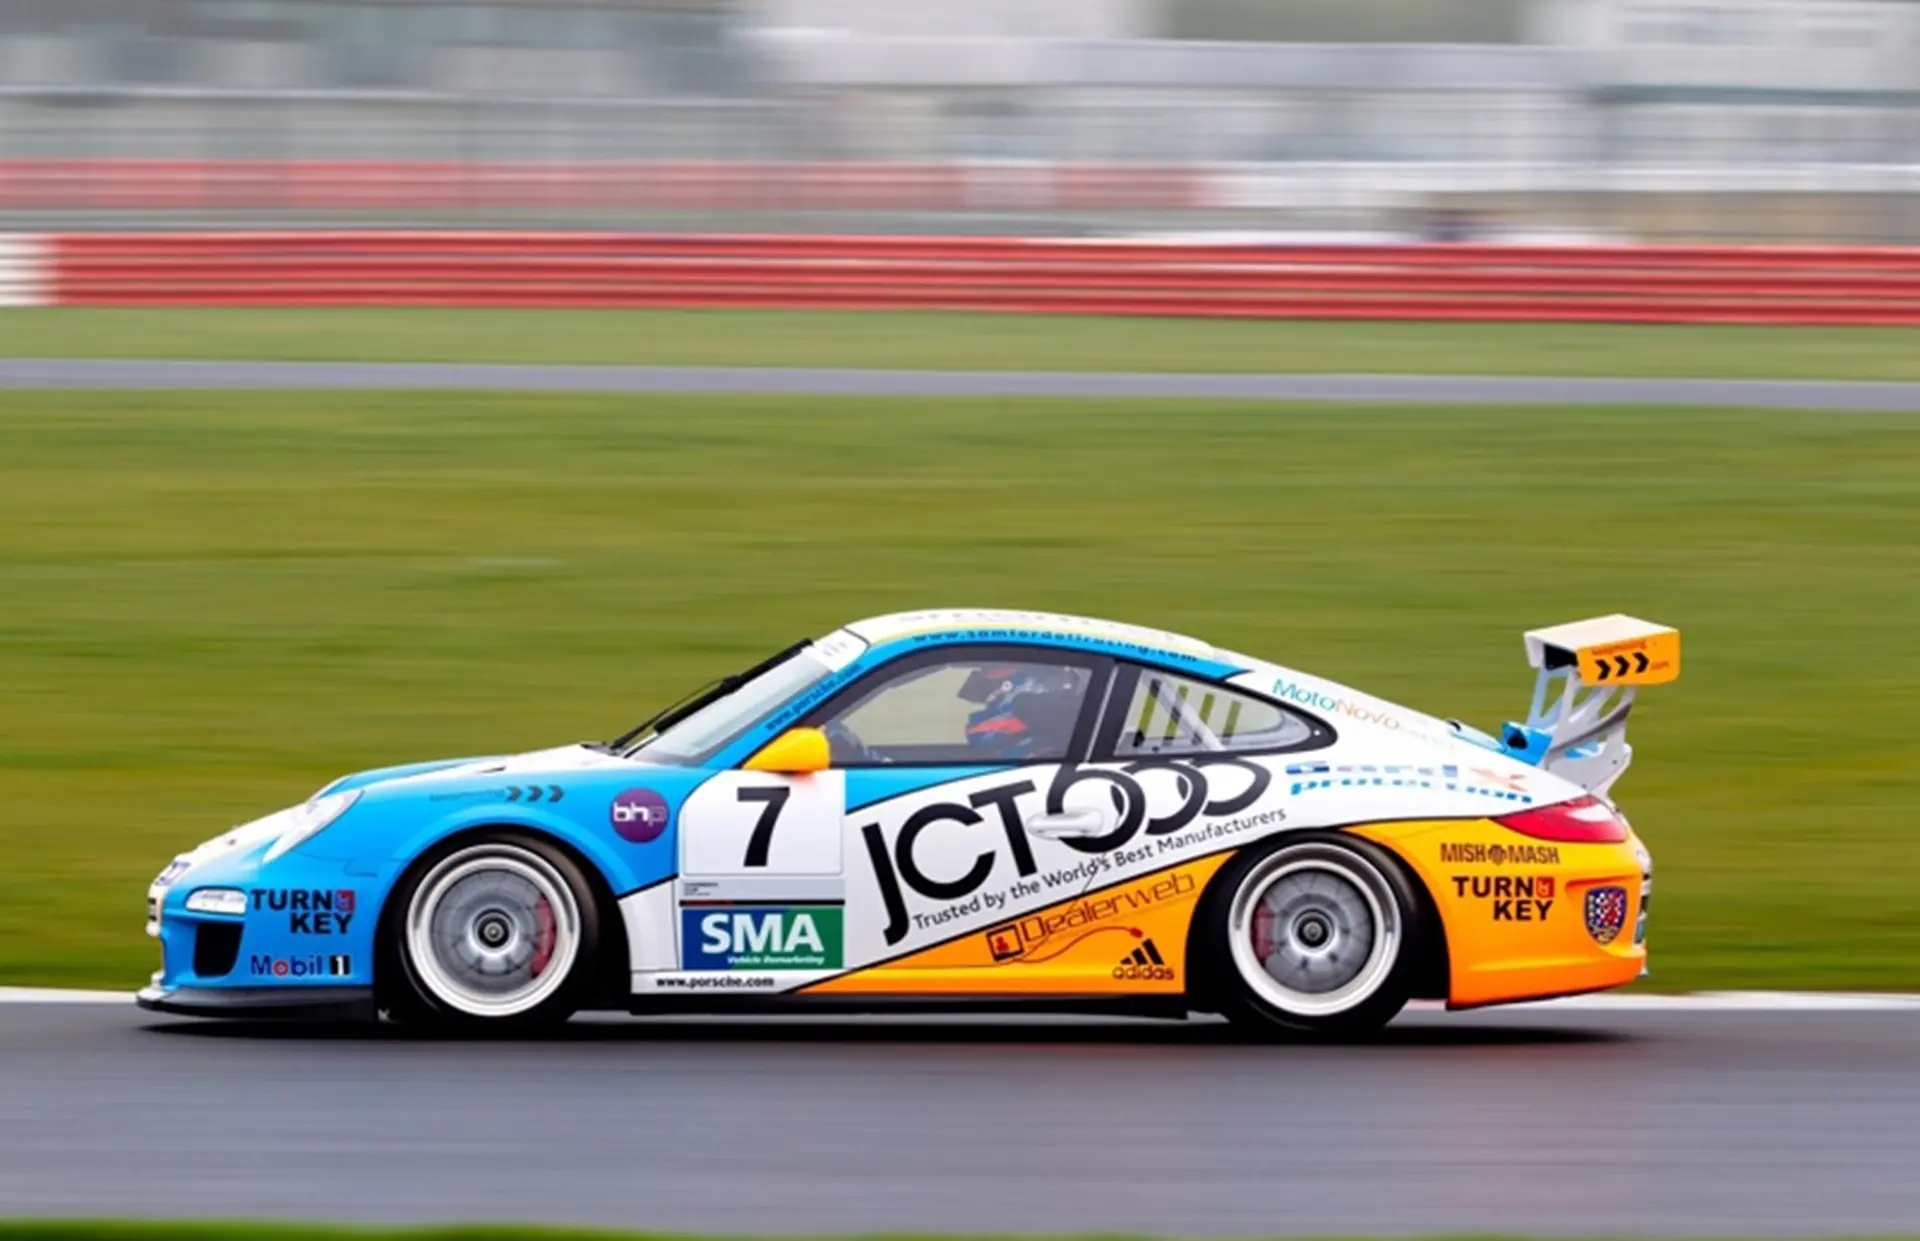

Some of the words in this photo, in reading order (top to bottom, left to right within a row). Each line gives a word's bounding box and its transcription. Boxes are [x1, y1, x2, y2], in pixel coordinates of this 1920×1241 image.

[1272, 678, 1400, 731] MotoNovo
[613, 802, 667, 827] bhp
[737, 786, 790, 867] 7
[1440, 843, 1486, 863] MISH
[1508, 847, 1560, 865] MASH
[912, 898, 982, 930] Trusted
[983, 892, 1006, 910] by
[1010, 878, 1041, 900] the
[1041, 851, 1112, 888] World's
[1113, 843, 1154, 868] Best
[1155, 808, 1288, 854] Manufacturers
[1452, 876, 1534, 898] TURN
[251, 889, 333, 911] TURN
[1020, 873, 1196, 942] Dealerweb
[1493, 900, 1553, 921] KEY
[290, 911, 354, 934] KEY
[701, 913, 824, 953] SMA
[250, 954, 323, 976] Mobil
[727, 955, 761, 964] Vehicle
[656, 977, 775, 989] www.porsche.com
[1112, 964, 1175, 981] adidas
